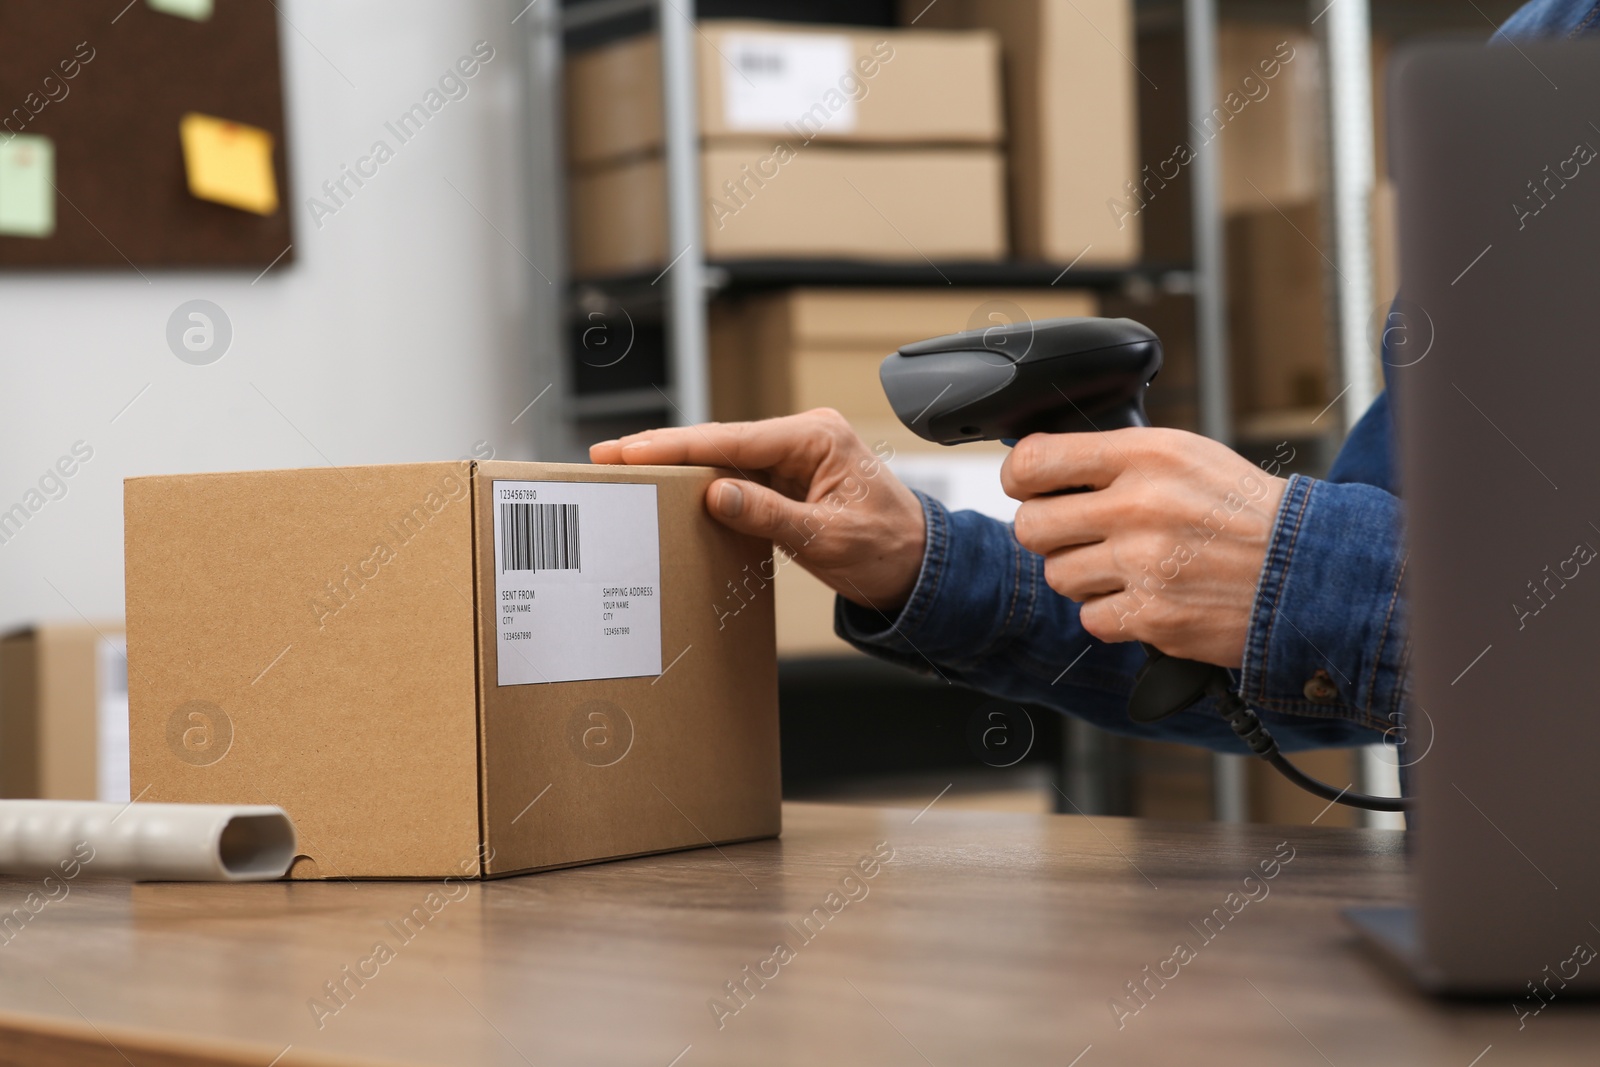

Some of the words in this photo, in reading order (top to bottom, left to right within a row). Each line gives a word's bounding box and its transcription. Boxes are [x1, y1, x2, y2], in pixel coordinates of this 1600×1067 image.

[500, 490, 537, 500] 1234567890
[502, 590, 517, 601] SENT
[518, 590, 535, 600] FROM
[603, 587, 628, 597] SHIPPING
[629, 587, 653, 597] ADDRESS
[502, 605, 516, 613] YOUR
[517, 604, 531, 613] NAME
[603, 601, 615, 610] YOUR
[616, 601, 629, 609] NAME
[502, 617, 514, 625] CITY
[603, 612, 613, 621] CITY
[503, 631, 532, 640] 1234567890
[603, 627, 630, 636] 1234567890
